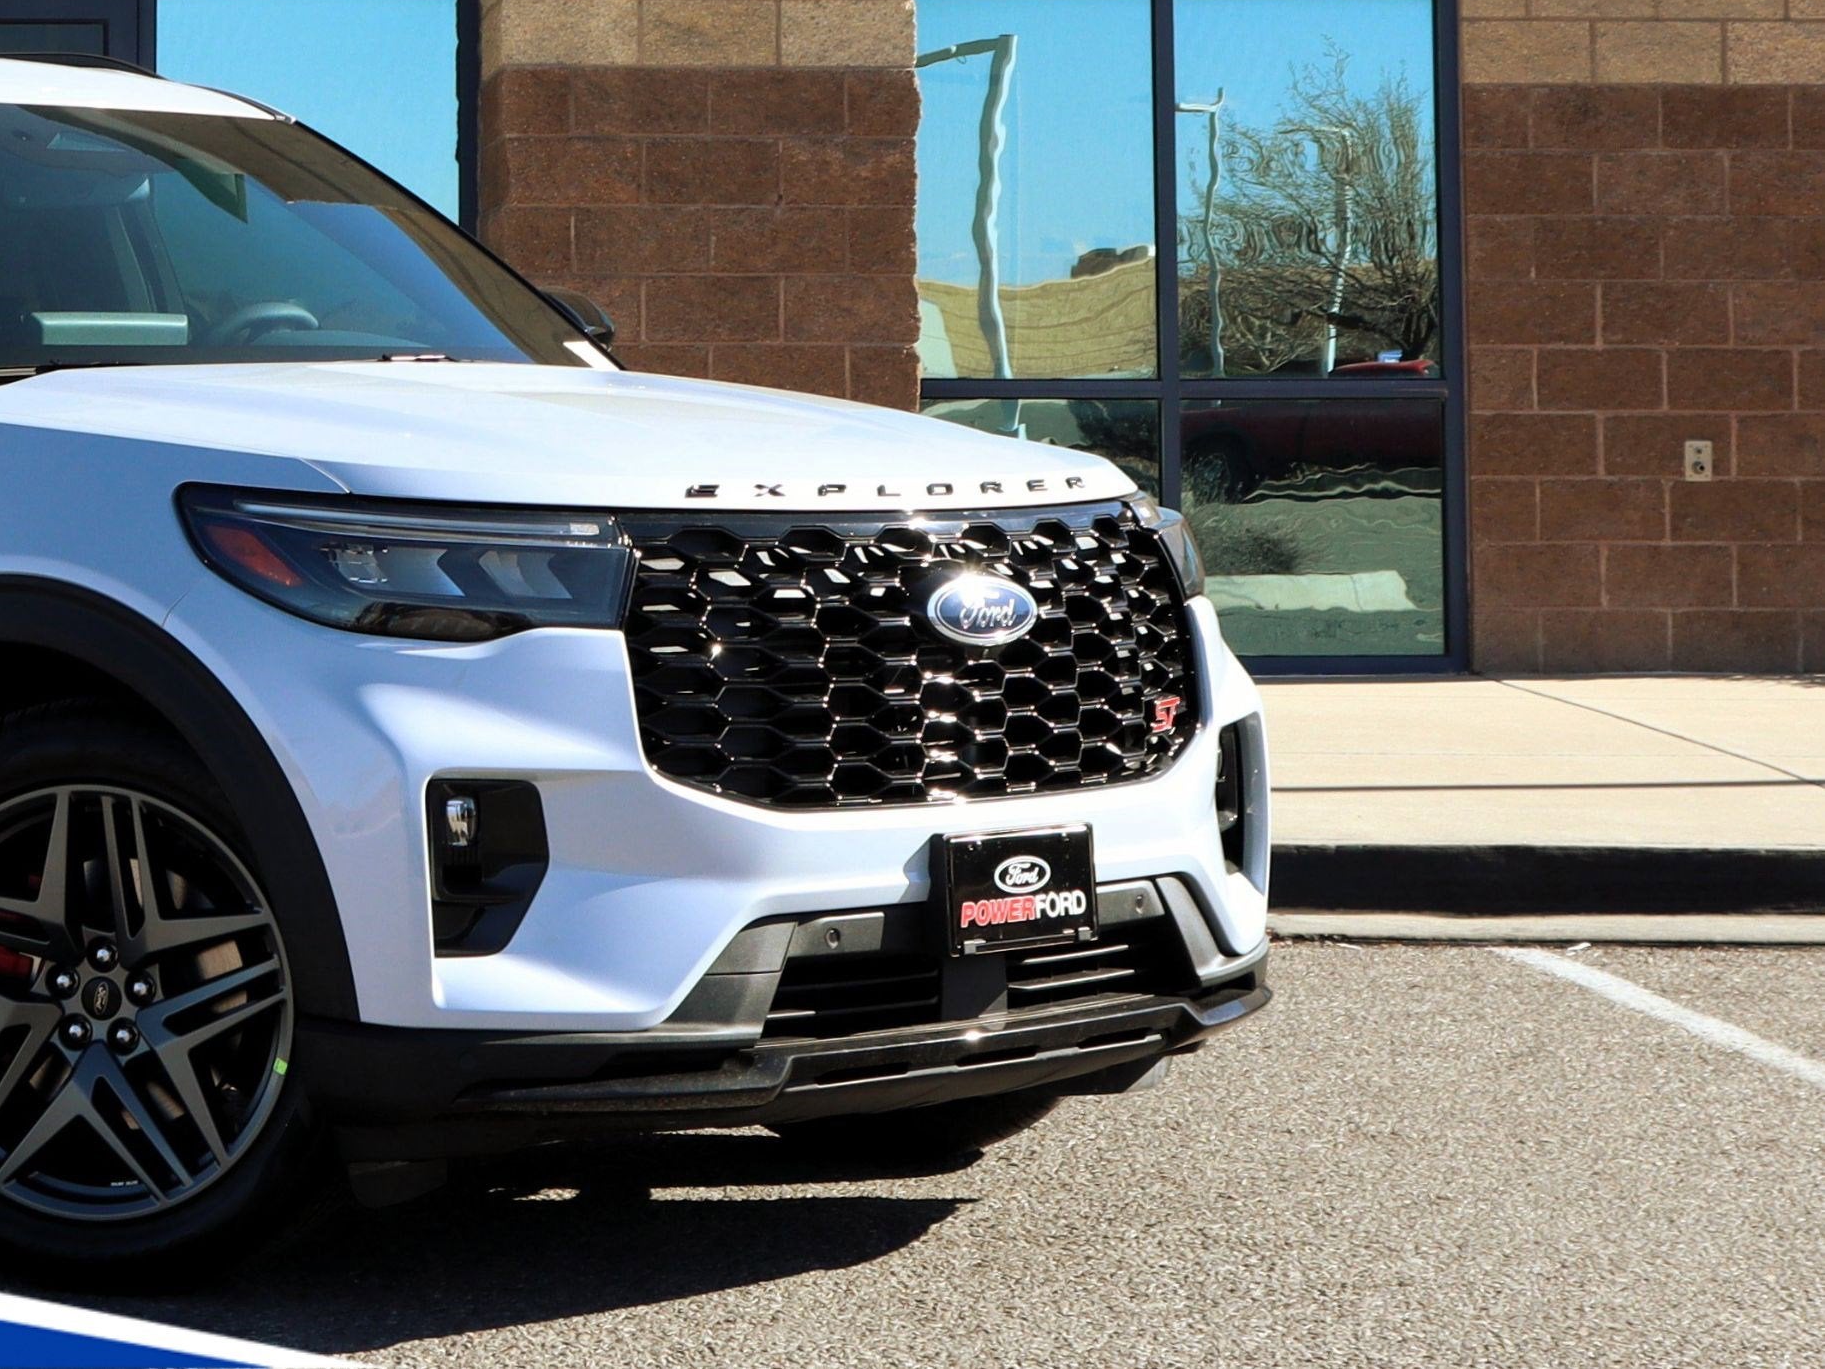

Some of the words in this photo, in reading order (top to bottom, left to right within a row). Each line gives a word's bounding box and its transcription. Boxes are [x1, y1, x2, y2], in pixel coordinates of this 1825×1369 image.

[684, 476, 1085, 498] EXPLORER
[959, 592, 1017, 629] Ford
[1150, 697, 1180, 733] ST
[1005, 862, 1039, 886] Ford
